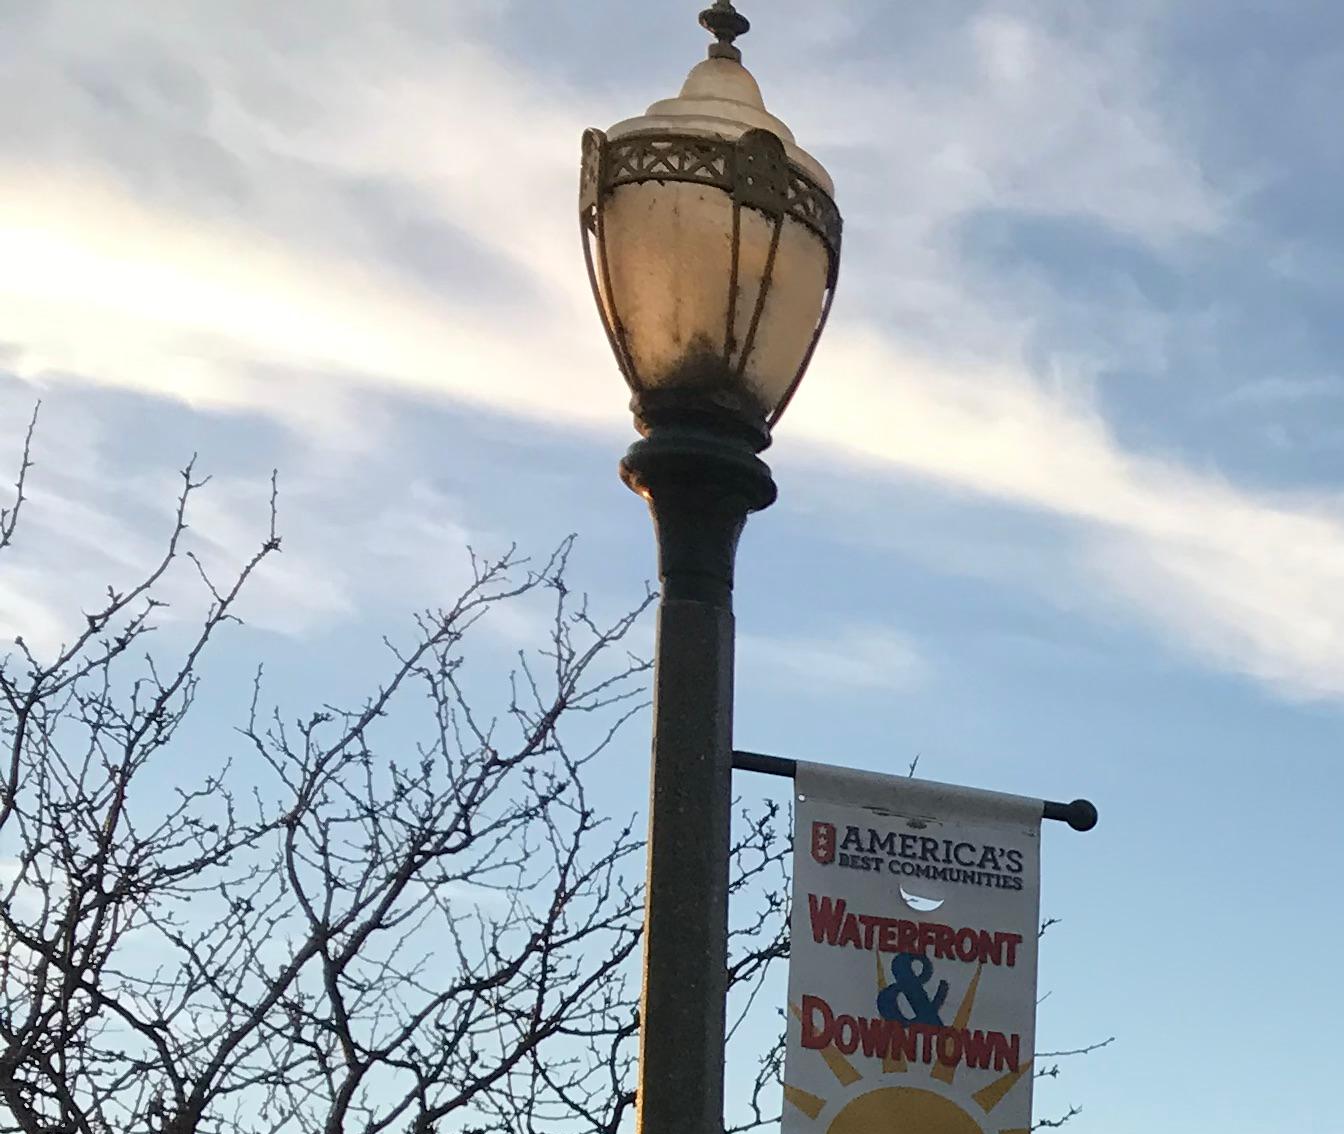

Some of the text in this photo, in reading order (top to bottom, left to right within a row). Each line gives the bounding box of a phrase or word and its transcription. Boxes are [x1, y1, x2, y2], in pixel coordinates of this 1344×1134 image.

[839, 851, 1023, 891] BEST COMMUNITIES
[840, 825, 1023, 873] AMERICA'S
[808, 893, 1023, 968] WATERFRONT
[877, 952, 949, 1029] &
[801, 994, 1020, 1073] DOWNTOWN
